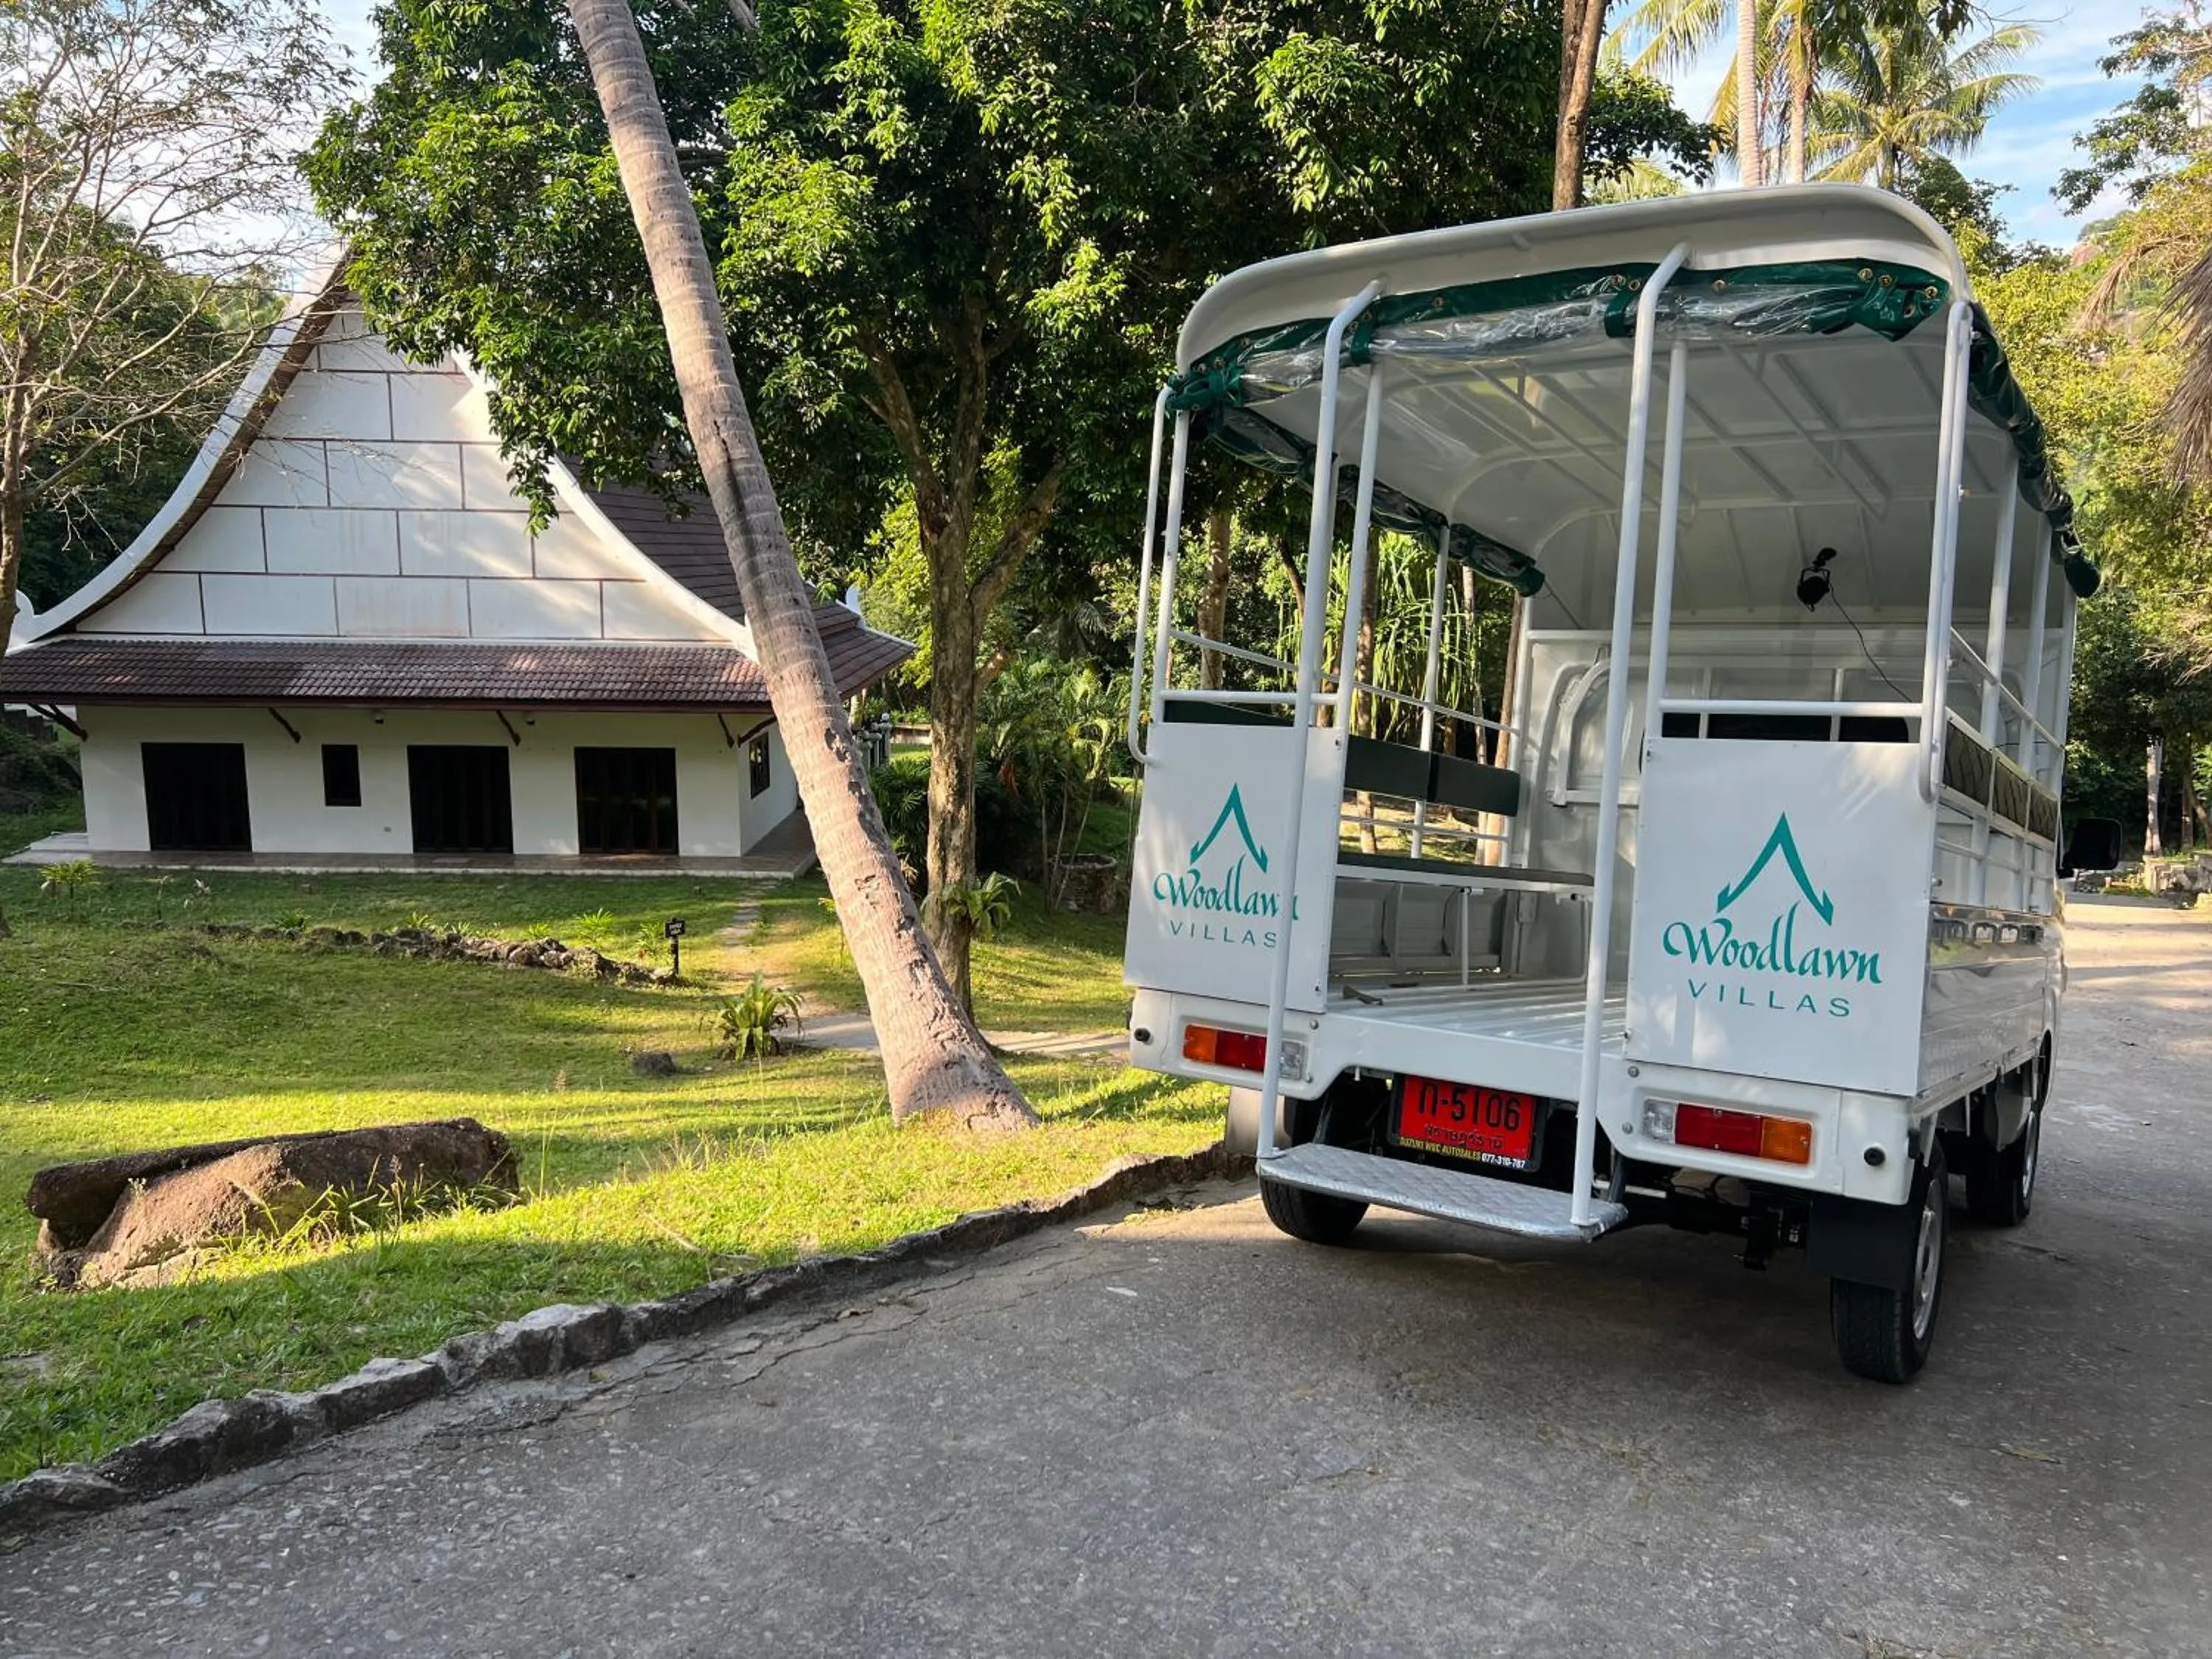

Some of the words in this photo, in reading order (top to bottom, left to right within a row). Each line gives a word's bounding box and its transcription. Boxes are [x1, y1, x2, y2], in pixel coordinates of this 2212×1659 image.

[1170, 919, 1277, 948] VILLAS
[1663, 900, 1882, 984] Woodlawn
[1688, 978, 1851, 1018] VILLAS
